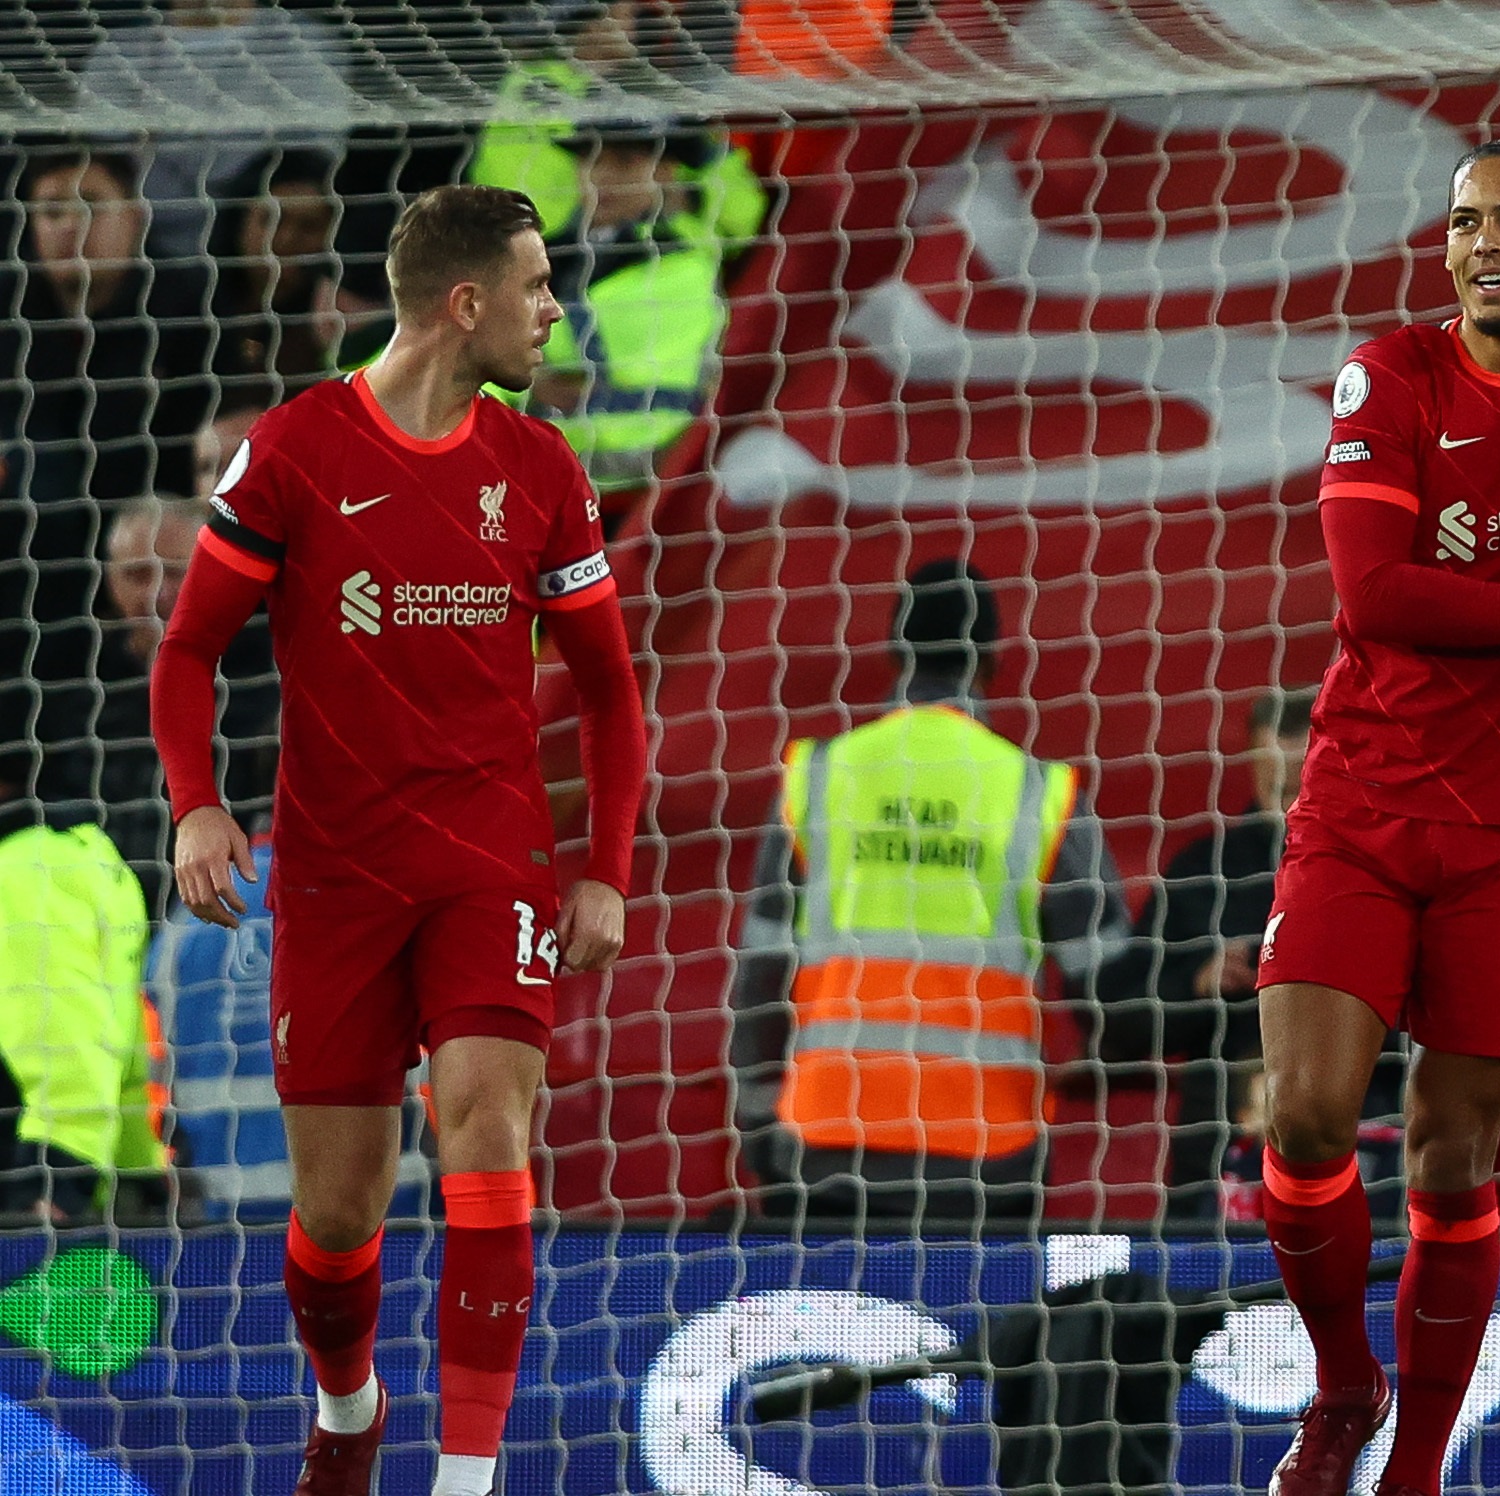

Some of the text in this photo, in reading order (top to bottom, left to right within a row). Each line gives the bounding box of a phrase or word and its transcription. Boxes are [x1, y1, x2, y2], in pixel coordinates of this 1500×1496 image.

[393, 581, 511, 604] standard
[393, 603, 509, 626] chartered
[882, 798, 957, 828] HEAD
[855, 832, 984, 868] STEWARD
[513, 900, 558, 978] 14
